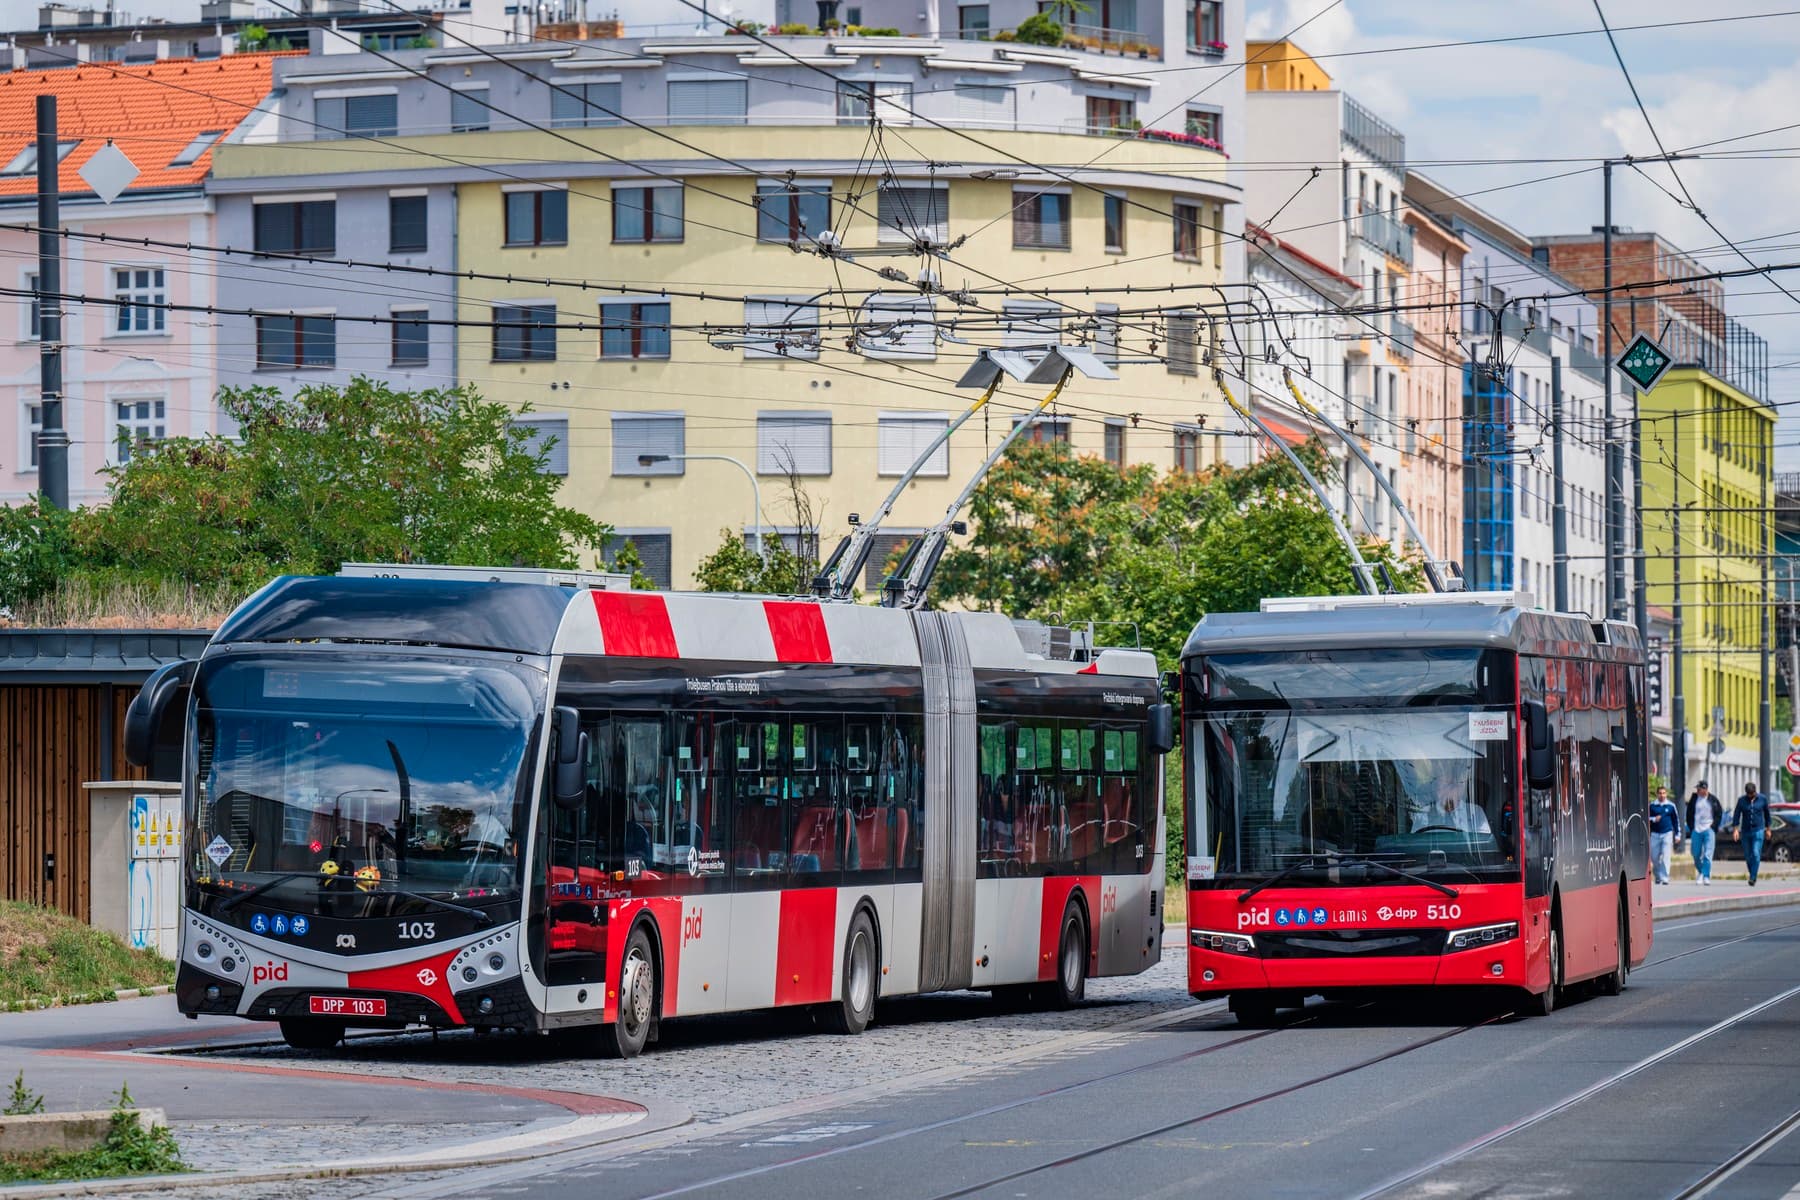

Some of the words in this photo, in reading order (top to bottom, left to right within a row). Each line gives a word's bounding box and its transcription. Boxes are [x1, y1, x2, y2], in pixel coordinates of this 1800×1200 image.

[628, 860, 640, 876] 103
[1103, 885, 1117, 920] pid
[1237, 907, 1270, 930] pid
[1395, 906, 1418, 919] dpp
[1426, 904, 1462, 920] 510
[398, 922, 436, 939] 103
[684, 906, 703, 948] pid
[253, 961, 288, 984] pid
[524, 963, 530, 973] 2
[322, 999, 345, 1013] DPP
[352, 1000, 374, 1014] 103
